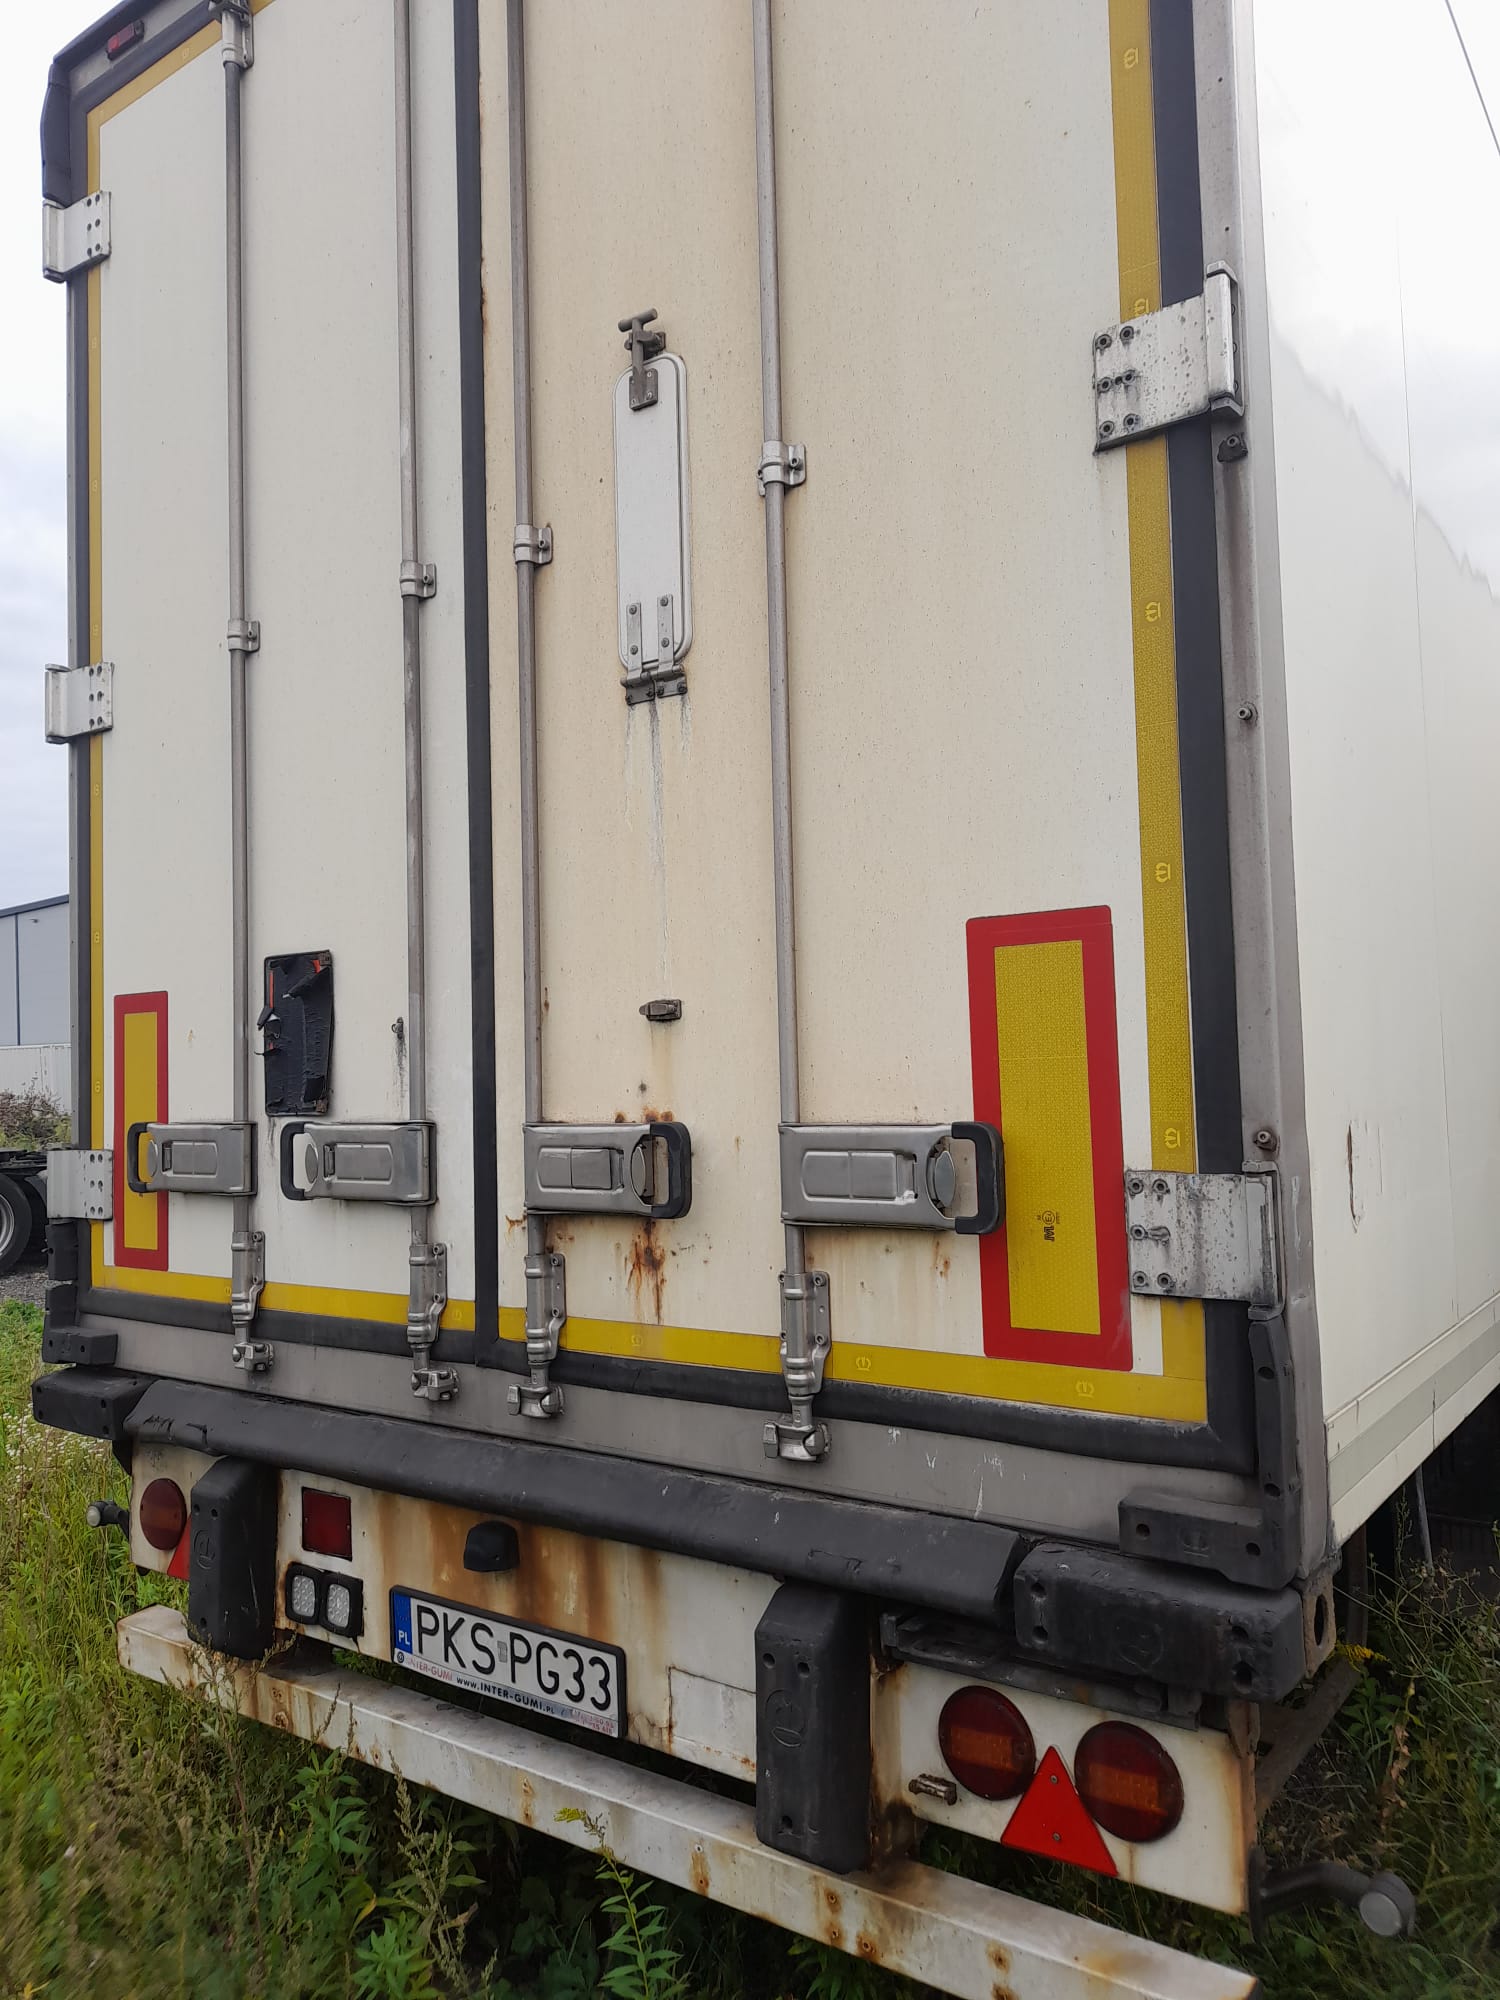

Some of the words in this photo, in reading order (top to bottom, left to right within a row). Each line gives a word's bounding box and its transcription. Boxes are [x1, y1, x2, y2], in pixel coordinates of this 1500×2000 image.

[398, 1630, 411, 1645] PL
[416, 1604, 496, 1675] PKS
[509, 1631, 611, 1711] PG33
